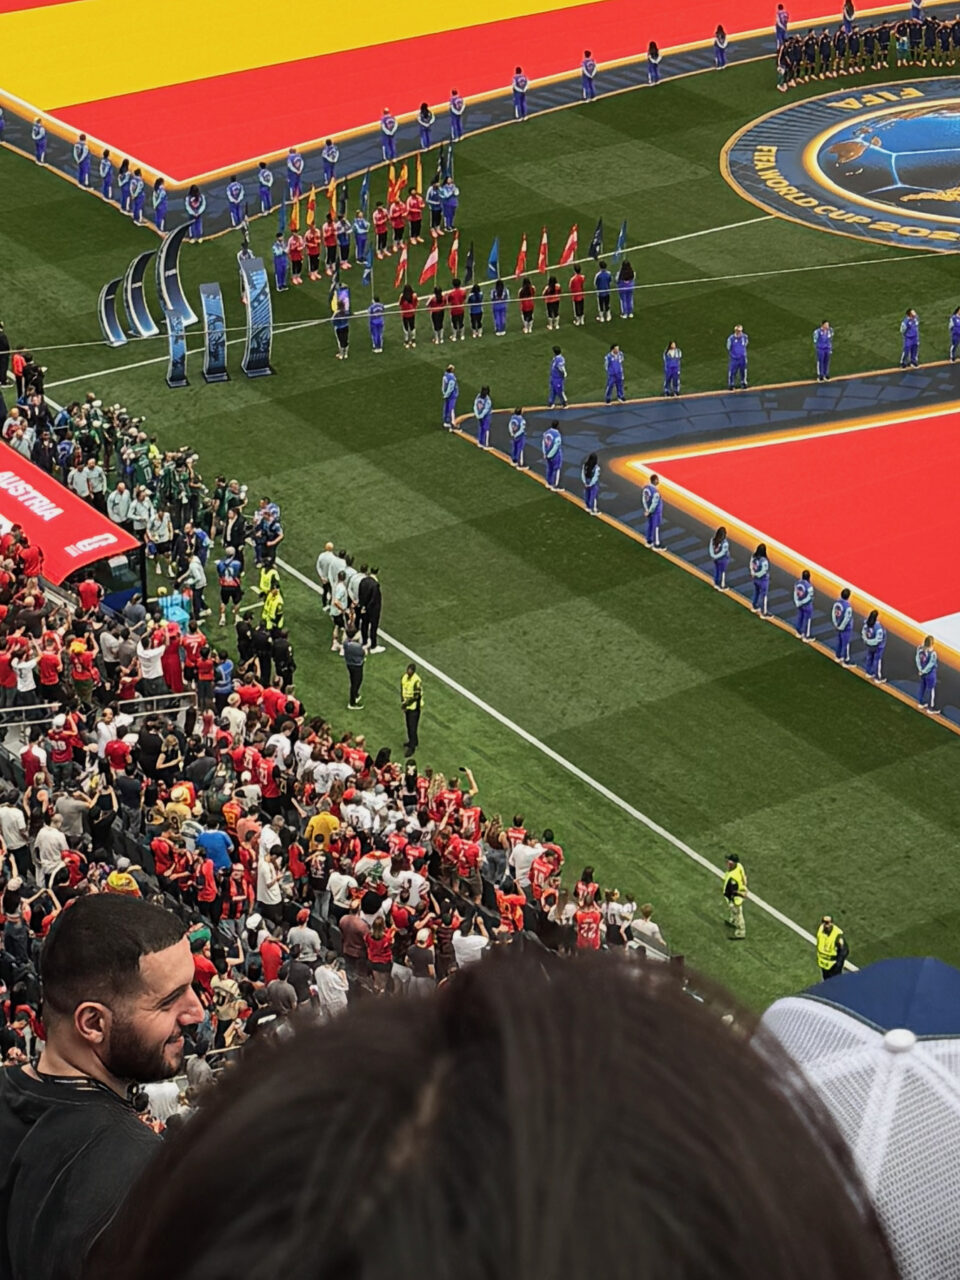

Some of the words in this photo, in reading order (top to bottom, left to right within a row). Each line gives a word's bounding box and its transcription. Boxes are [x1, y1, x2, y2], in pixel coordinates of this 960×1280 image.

[754, 145, 778, 170] FIFA
[757, 169, 819, 208] WORLD
[813, 205, 872, 225] CUP
[0, 471, 65, 522] AUSTRIA
[580, 923, 597, 939] 22
